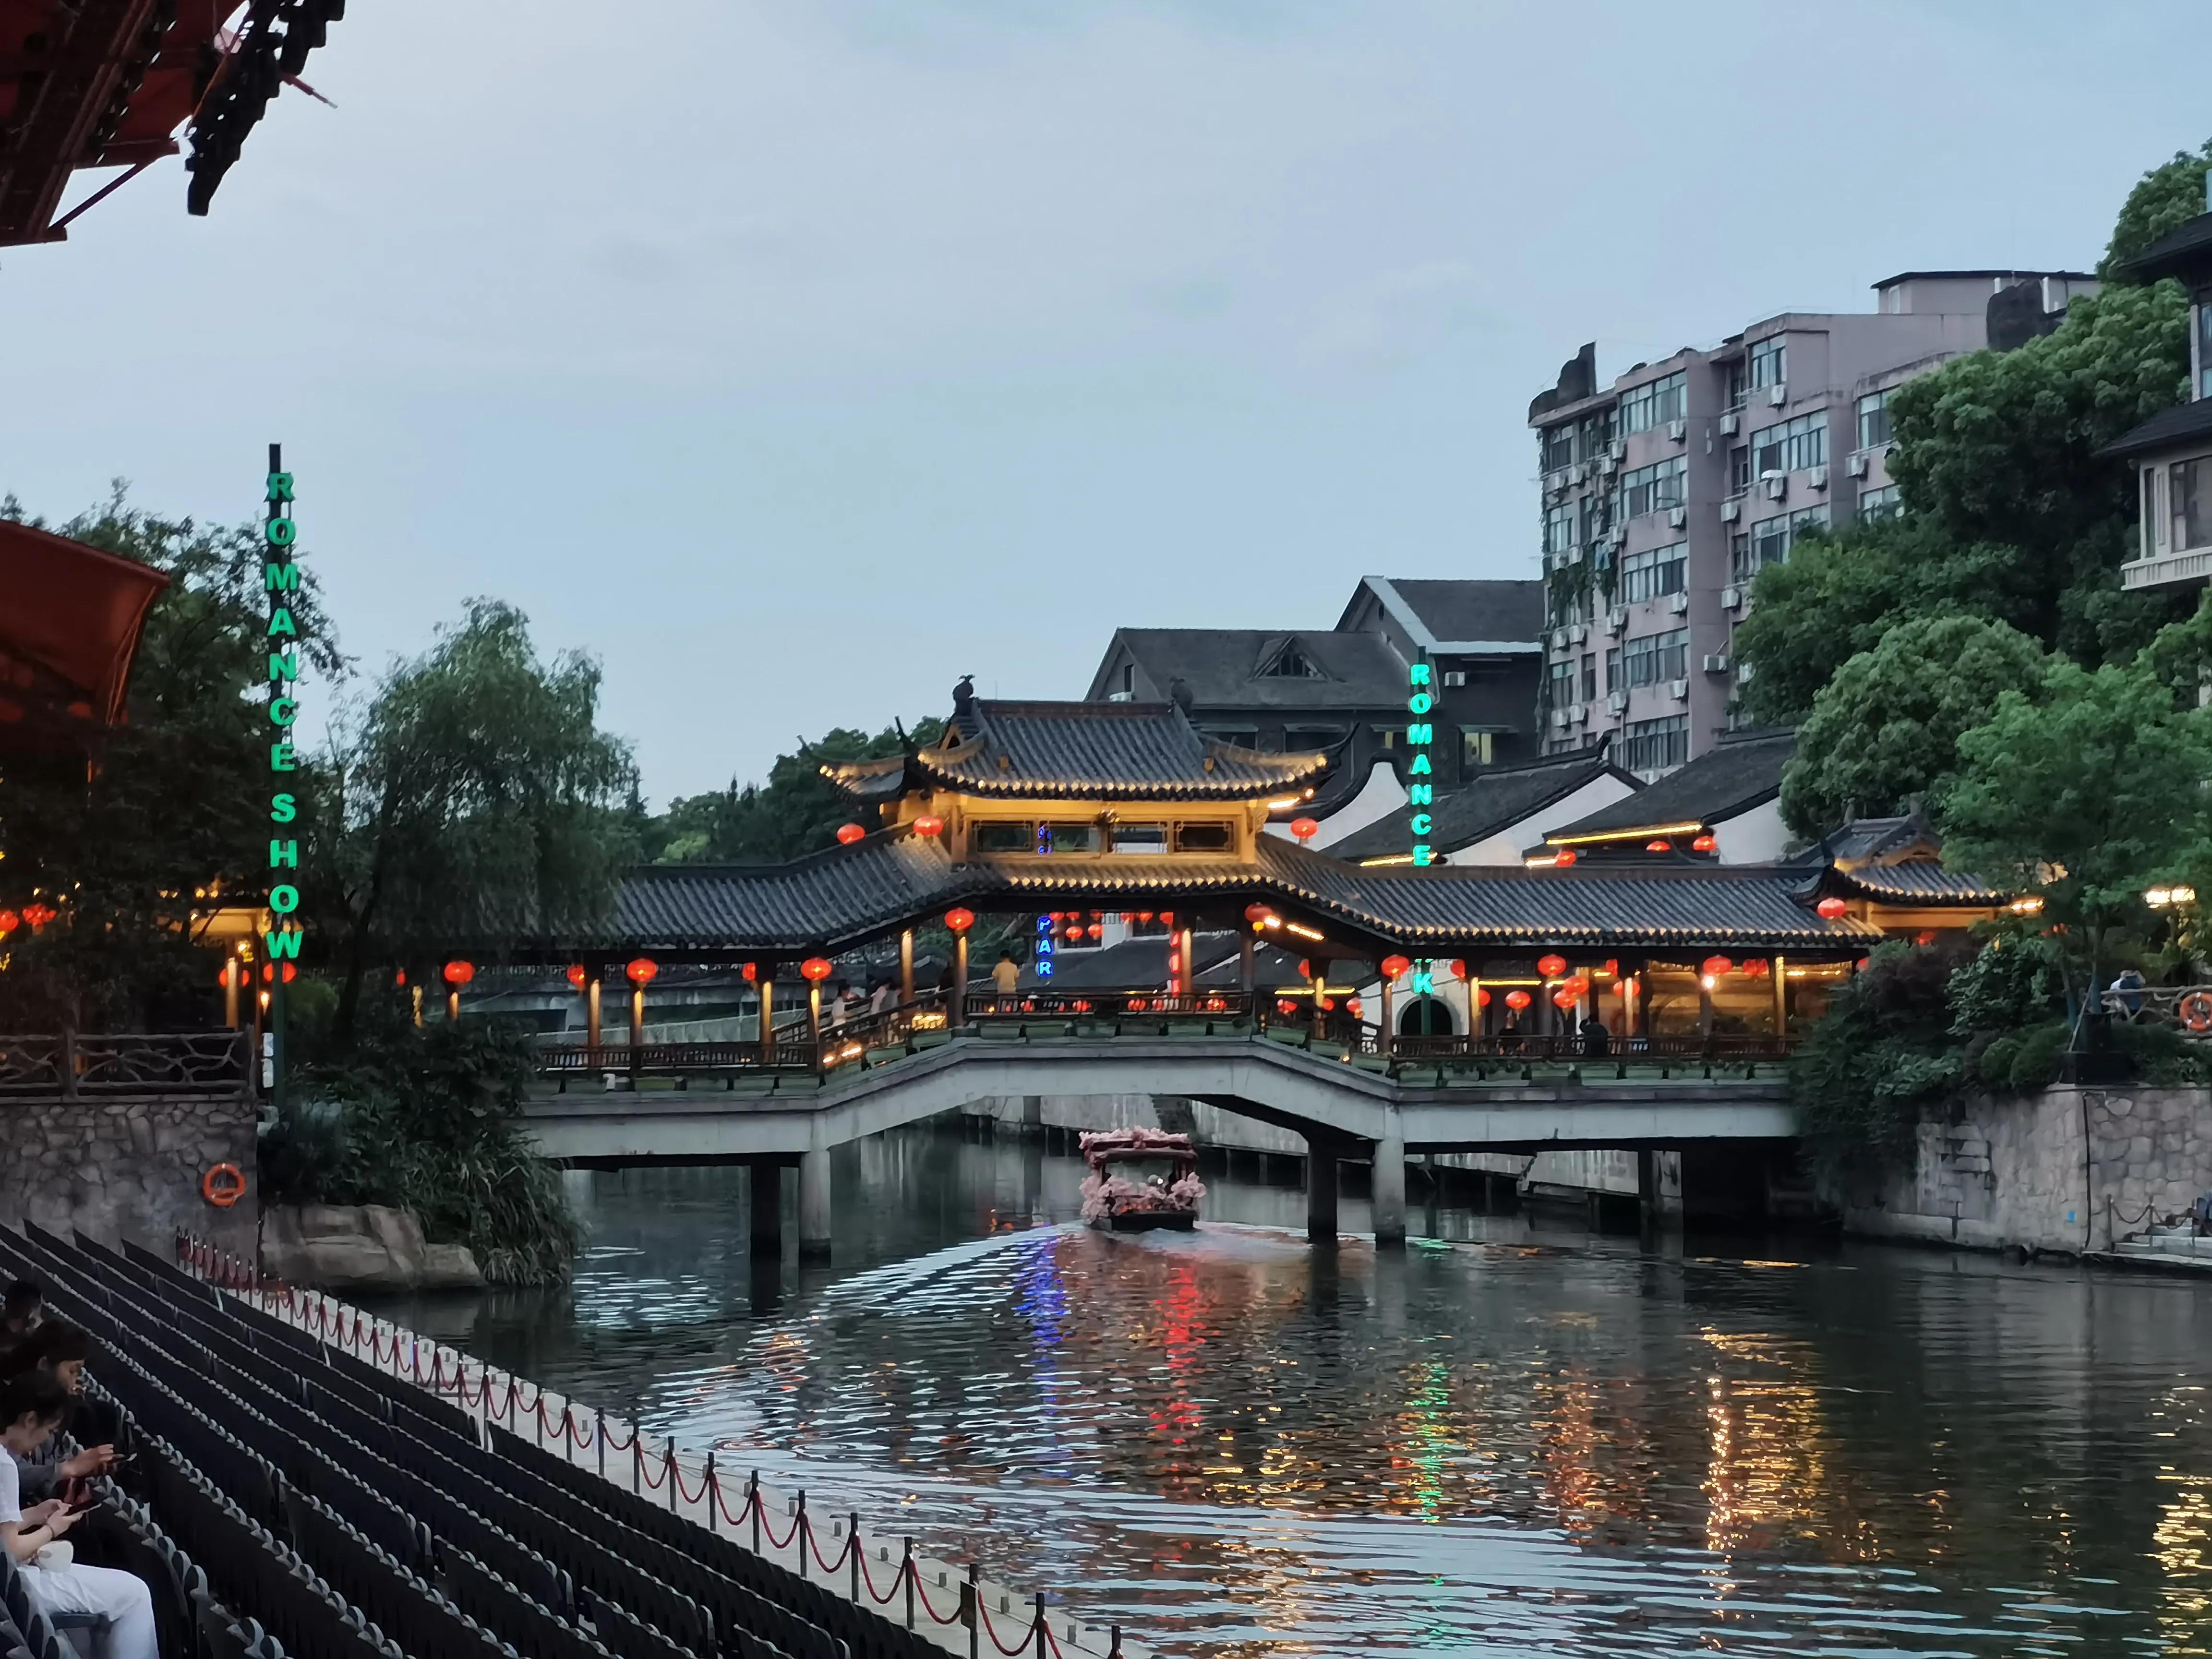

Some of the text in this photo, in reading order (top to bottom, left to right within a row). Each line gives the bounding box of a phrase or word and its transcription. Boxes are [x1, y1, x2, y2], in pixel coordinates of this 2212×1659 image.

[265, 472, 303, 959] ROMANCE SHOW
[1408, 663, 1434, 867] ROMANCE
